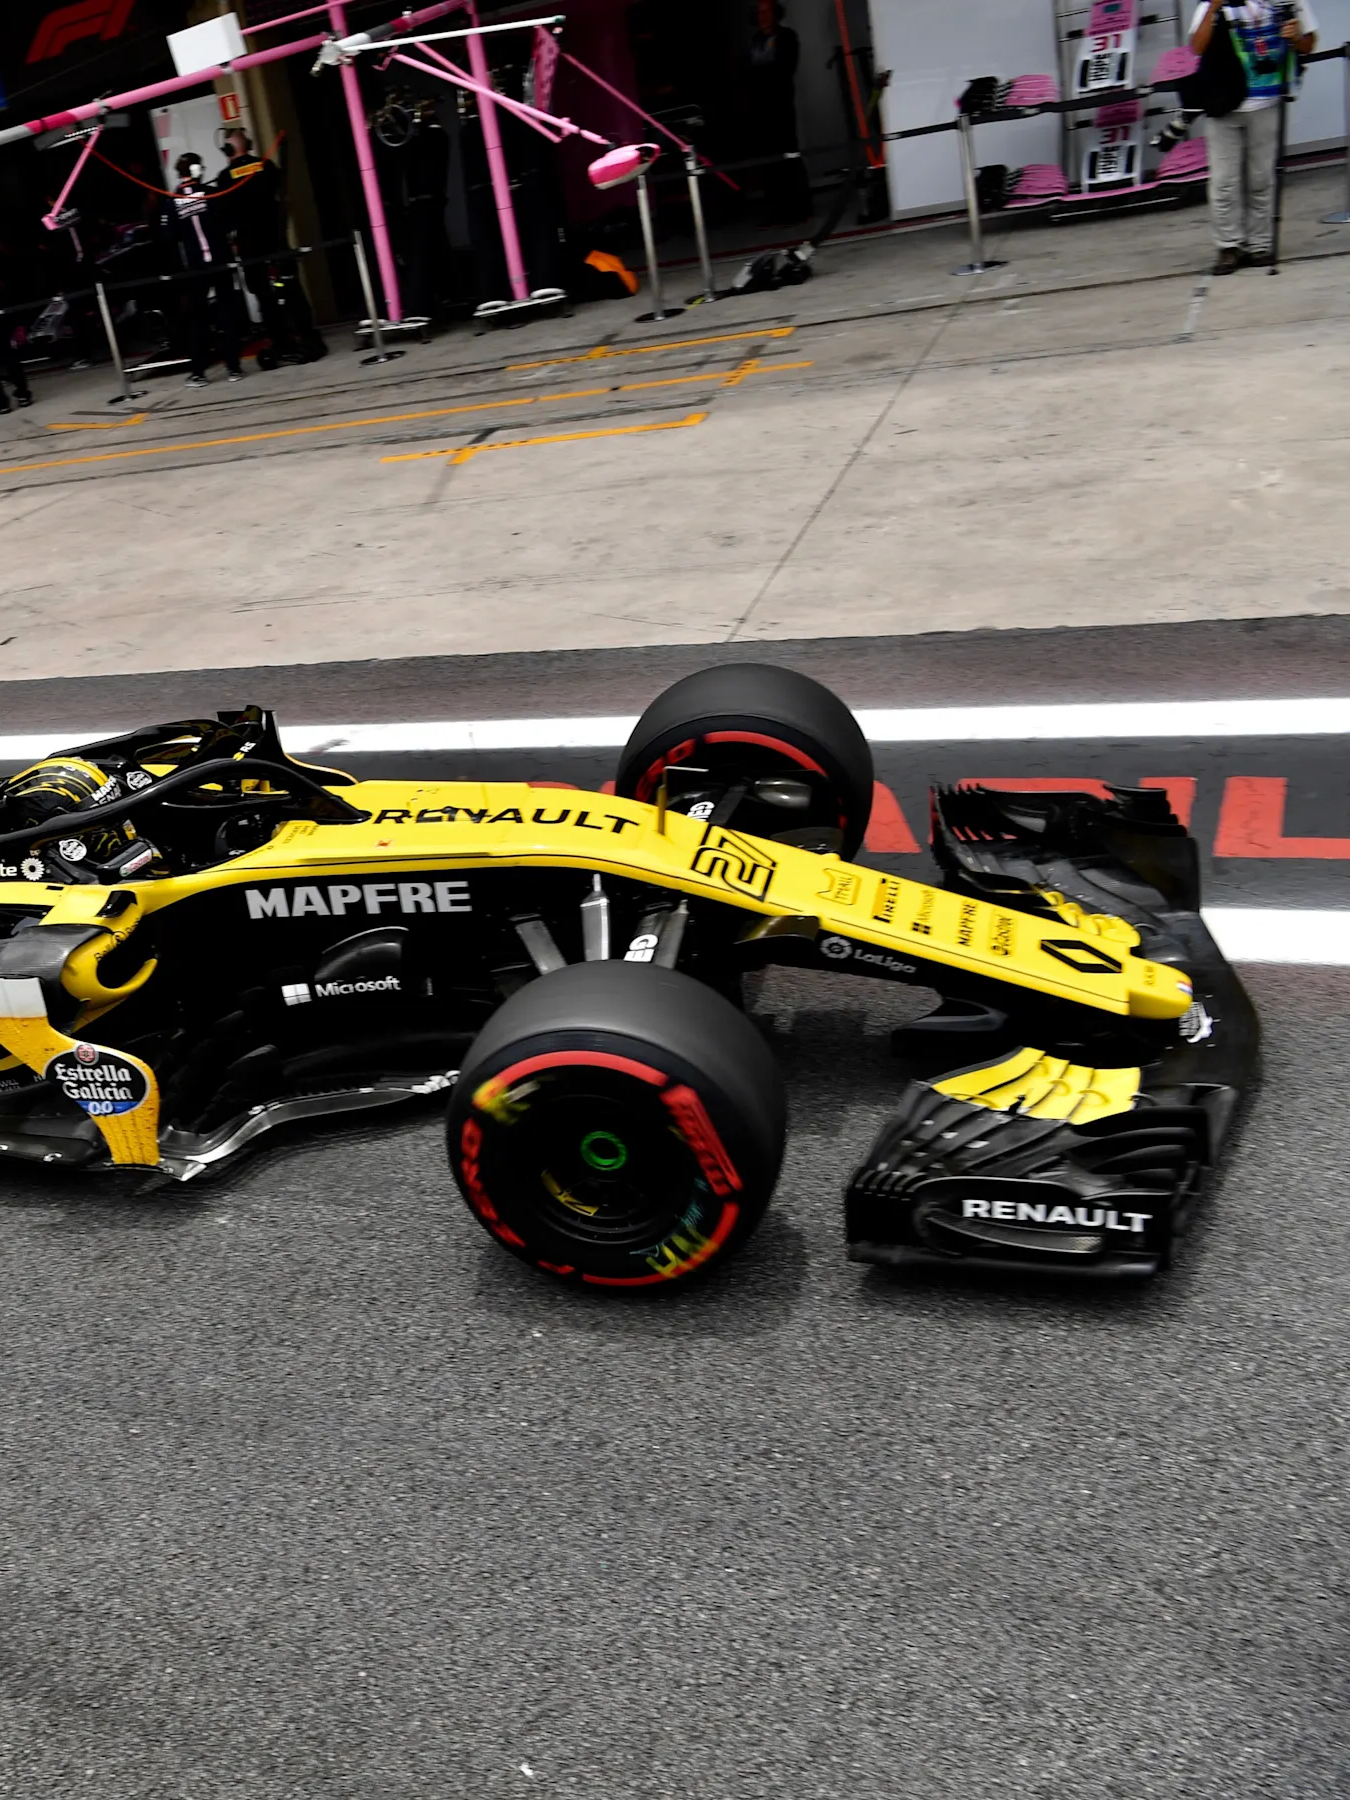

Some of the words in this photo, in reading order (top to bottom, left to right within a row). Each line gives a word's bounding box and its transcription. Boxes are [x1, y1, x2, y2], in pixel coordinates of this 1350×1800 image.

[1091, 34, 1122, 53] 31
[1099, 126, 1129, 145] 31
[690, 824, 778, 902] 27
[245, 880, 473, 919] MAPFRE
[957, 900, 978, 947] MAPFRE
[854, 949, 917, 974] LaLiga
[315, 975, 401, 997] Microsoft
[54, 1063, 132, 1082] Estrella
[62, 1082, 133, 1100] Galicia
[962, 1199, 1153, 1233] RENAULT
